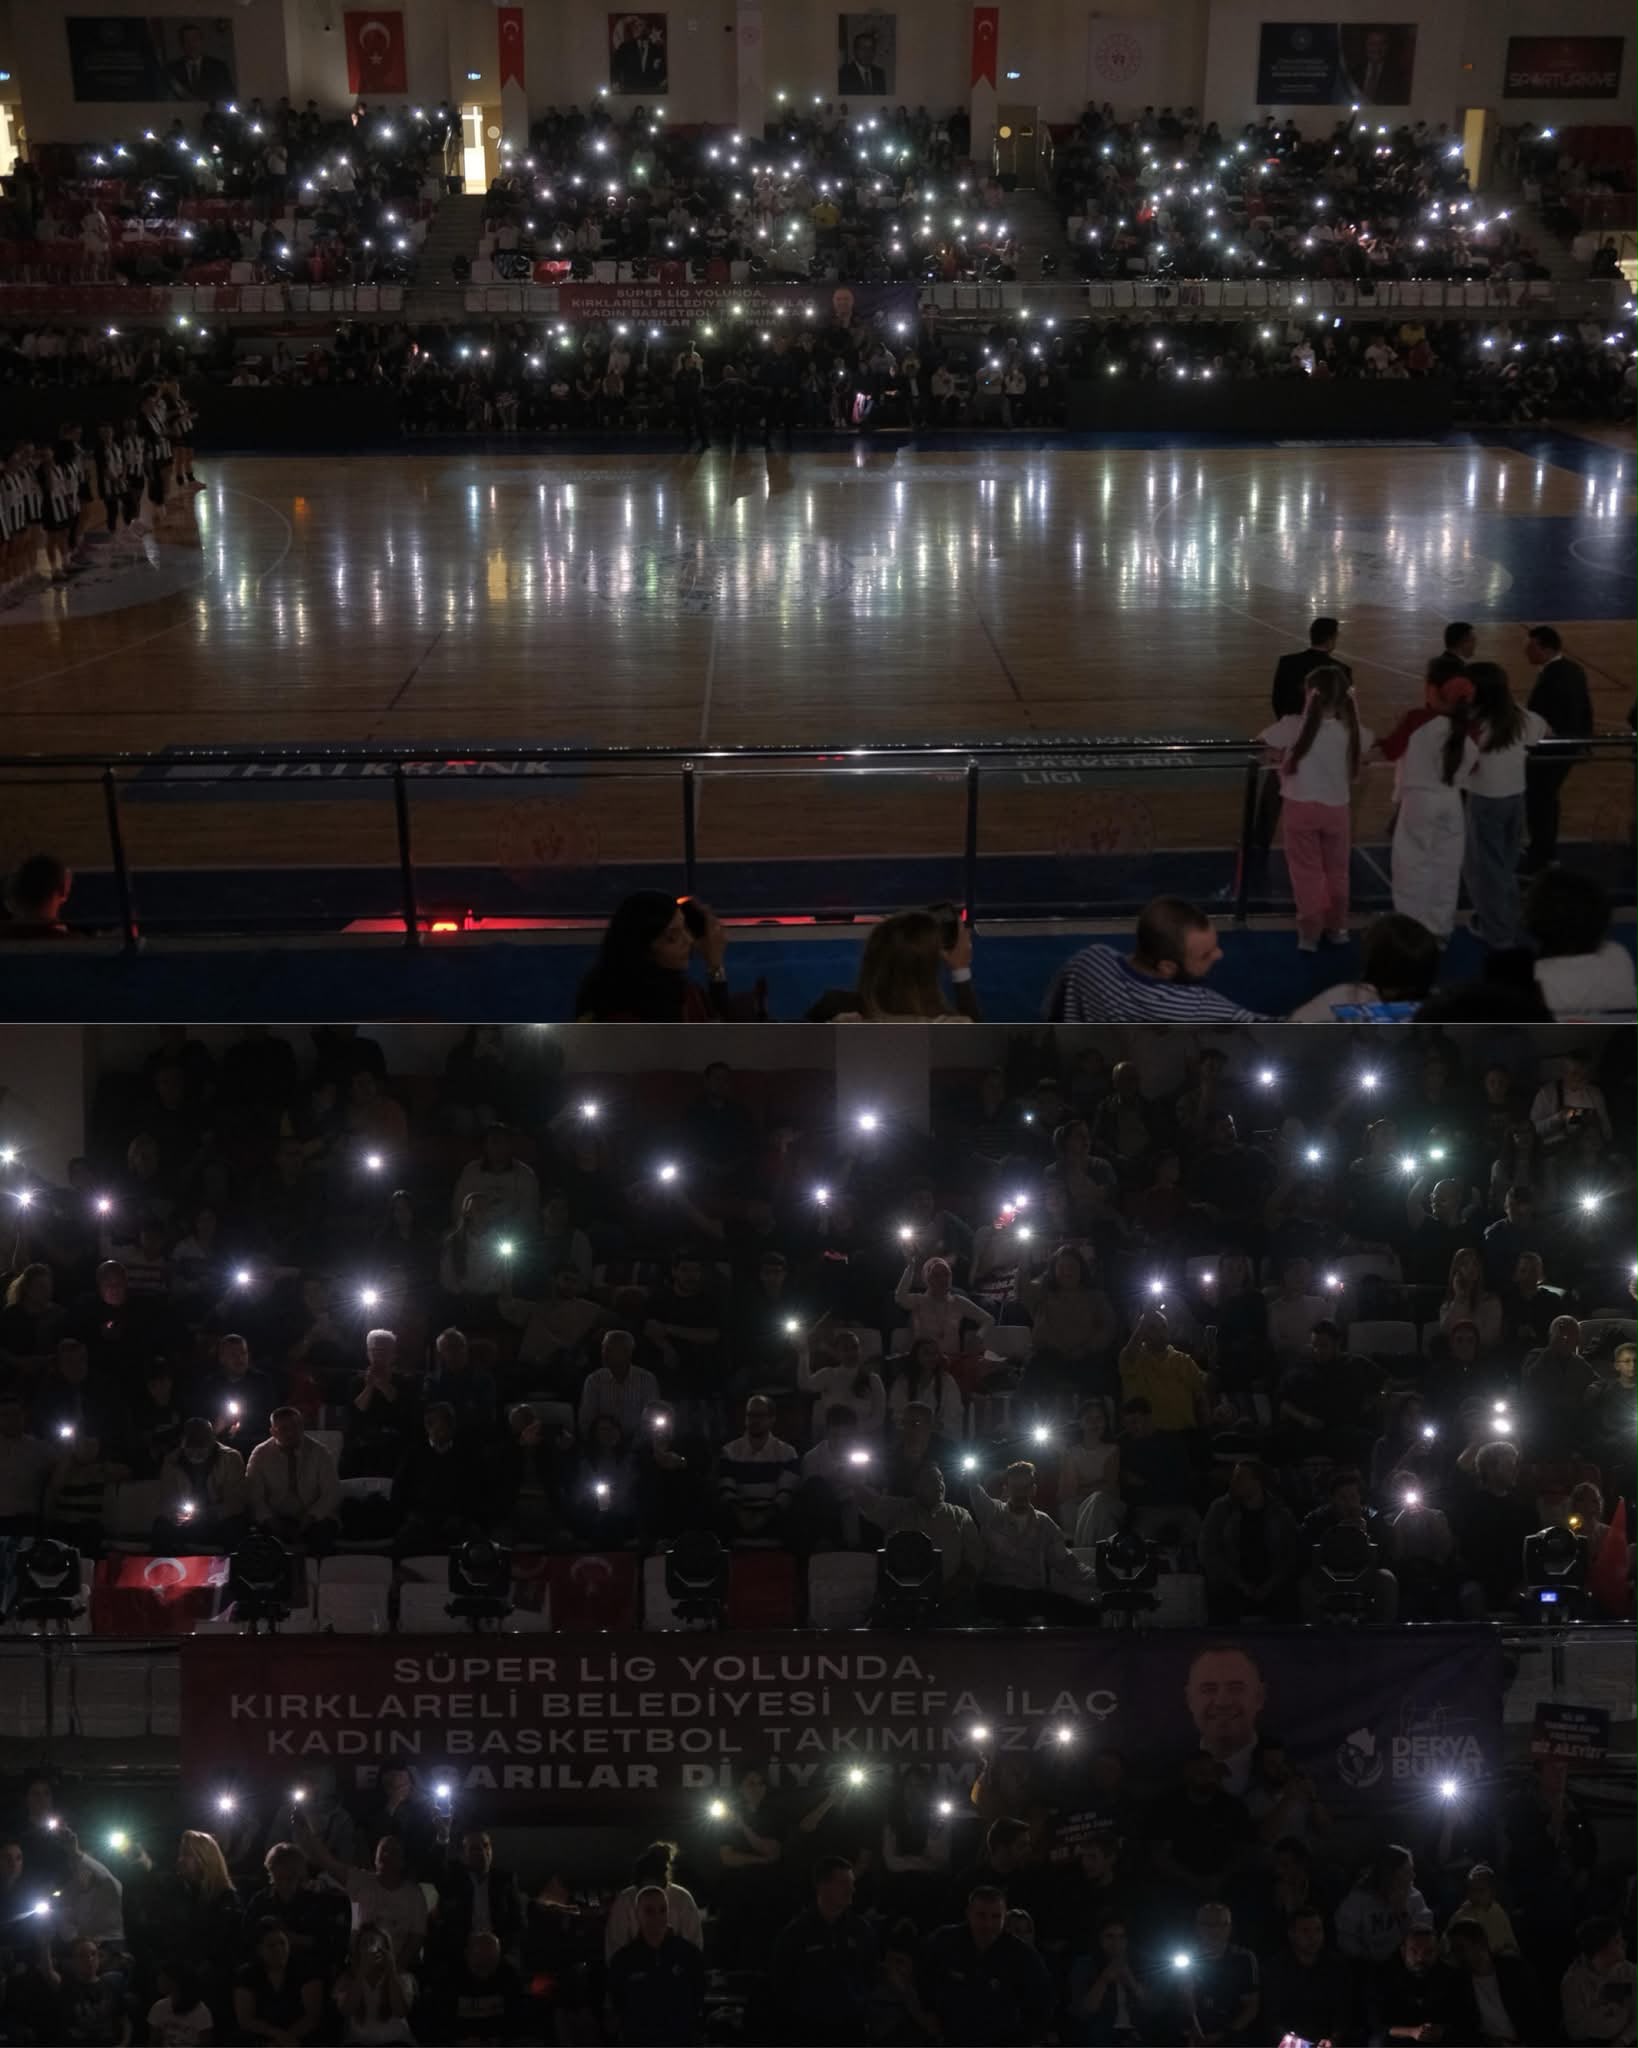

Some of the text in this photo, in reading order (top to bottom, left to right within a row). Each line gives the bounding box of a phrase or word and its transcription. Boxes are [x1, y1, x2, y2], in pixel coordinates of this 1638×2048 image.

[393, 1651, 937, 1684] SÜPER LİG YOLUNDA,
[230, 1686, 1119, 1720] KIRKLARELİ BELEDİYESİ VEFA İLAÇ
[267, 1729, 422, 1755] KADIN
[446, 1728, 743, 1754] BASKETBOL
[1391, 1735, 1482, 1757] DERYA
